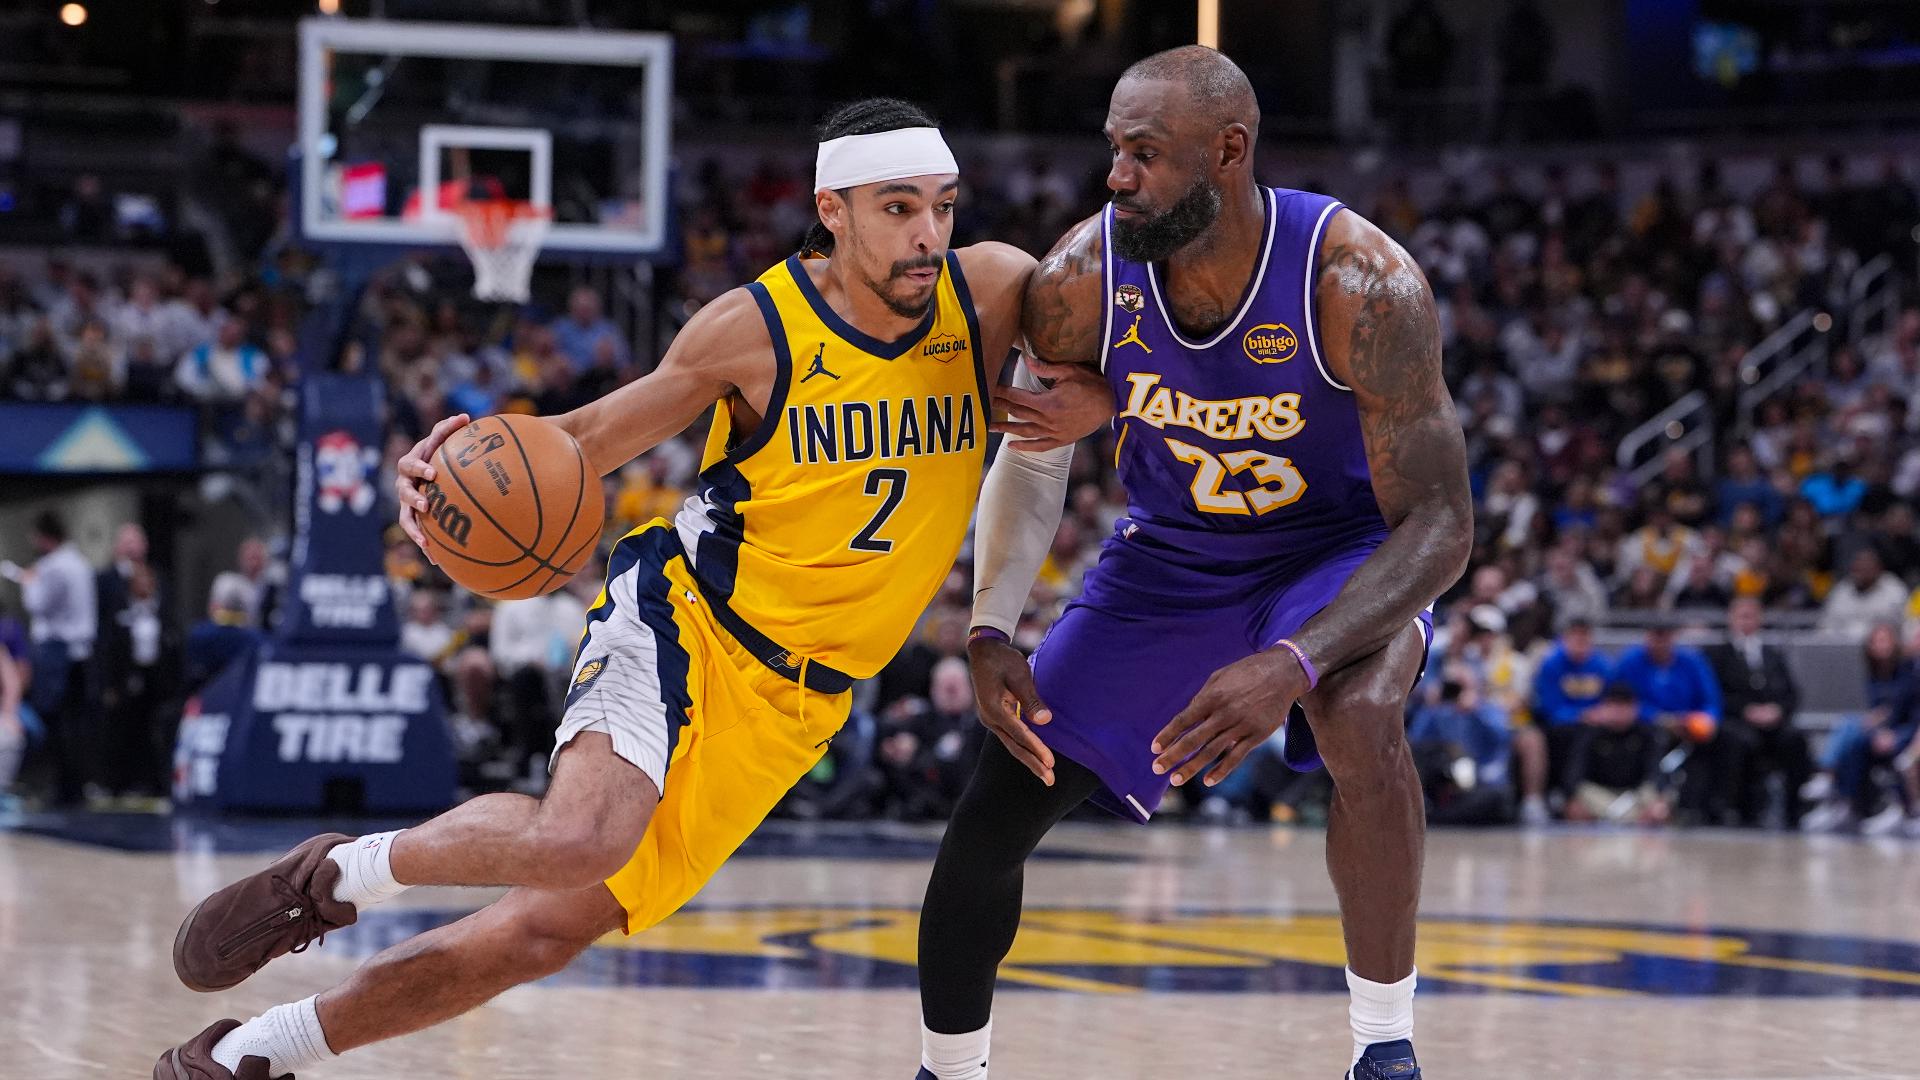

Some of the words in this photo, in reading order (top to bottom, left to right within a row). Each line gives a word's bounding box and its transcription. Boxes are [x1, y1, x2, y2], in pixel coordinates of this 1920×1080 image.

[923, 342, 951, 356] LUCAS
[952, 339, 967, 352] OIL
[1247, 335, 1295, 351] bibigo
[787, 393, 976, 464] INDIANA
[1119, 372, 1307, 442] LAKERS
[1163, 437, 1309, 516] 23
[848, 467, 909, 553] 2
[254, 662, 432, 714] BELLE
[271, 713, 407, 763] TIRE
